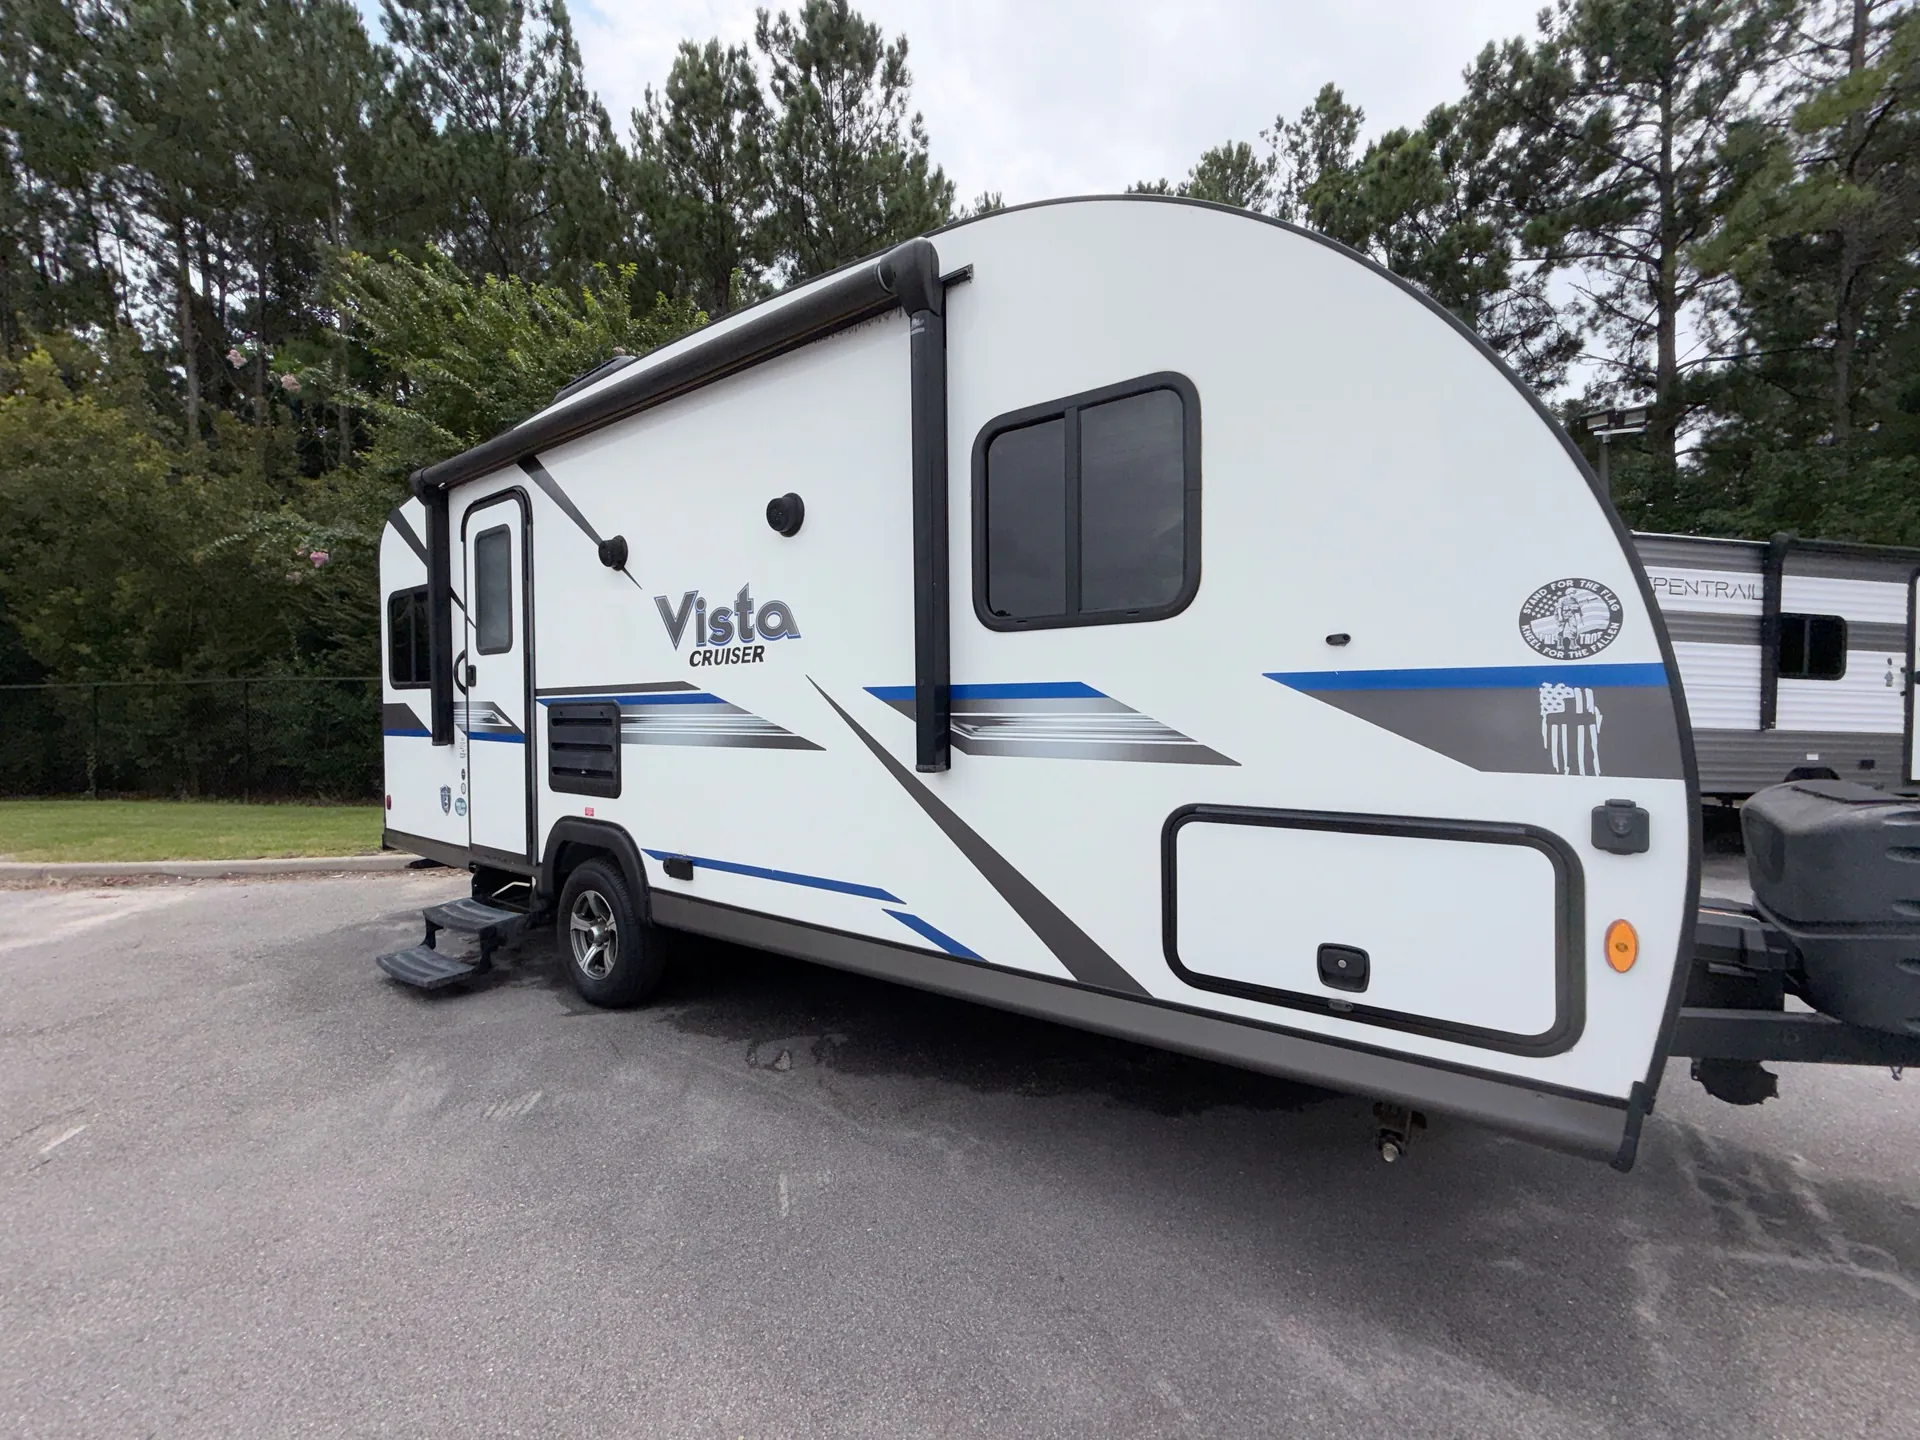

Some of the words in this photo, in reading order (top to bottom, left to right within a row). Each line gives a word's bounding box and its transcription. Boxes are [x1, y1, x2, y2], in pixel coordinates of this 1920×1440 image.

[1522, 588, 1548, 615] STAND
[1550, 579, 1574, 591] FOR
[1580, 579, 1600, 591] THE
[1600, 589, 1620, 612] FLAG
[1646, 576, 1764, 601] PENTRAIL
[653, 581, 801, 651] Vista
[689, 645, 765, 668] CRUISER
[1521, 624, 1540, 650] KNEEL
[1542, 647, 1565, 659] FOR
[1568, 648, 1590, 659] THE
[1590, 622, 1620, 652] FALLEN
